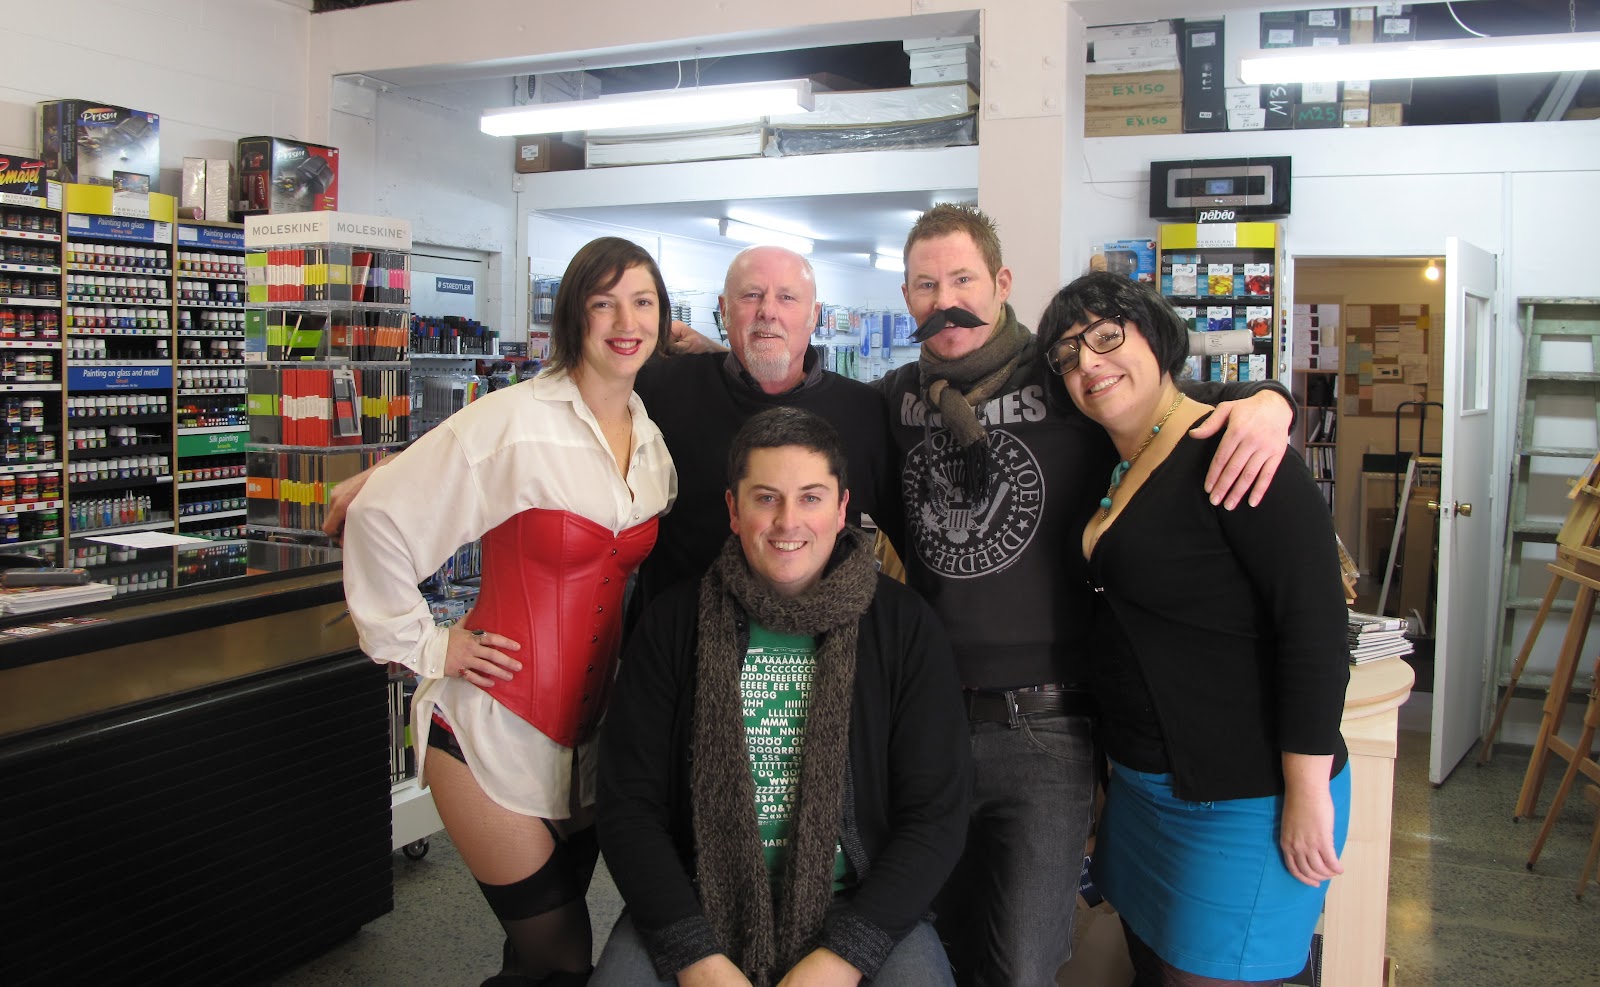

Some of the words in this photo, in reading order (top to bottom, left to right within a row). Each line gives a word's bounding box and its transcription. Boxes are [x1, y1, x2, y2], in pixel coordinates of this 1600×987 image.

[1112, 84, 1165, 96] EX150
[1269, 83, 1289, 116] M3
[80, 112, 118, 122] Prism
[1298, 107, 1336, 121] M25
[1126, 116, 1168, 126] EX150
[98, 218, 121, 228] Painting
[131, 222, 145, 230] glass
[203, 228, 223, 239] Painting
[442, 282, 472, 291] STAEDTLER
[83, 368, 106, 379] Painting
[117, 368, 131, 378] glass
[132, 368, 142, 377] and
[143, 368, 159, 377] metal
[208, 435, 218, 443] Silk
[218, 434, 239, 444] painting
[1010, 458, 1040, 520] JOEY
[932, 528, 1025, 574] DEEDEE
[761, 718, 788, 726] MMM
